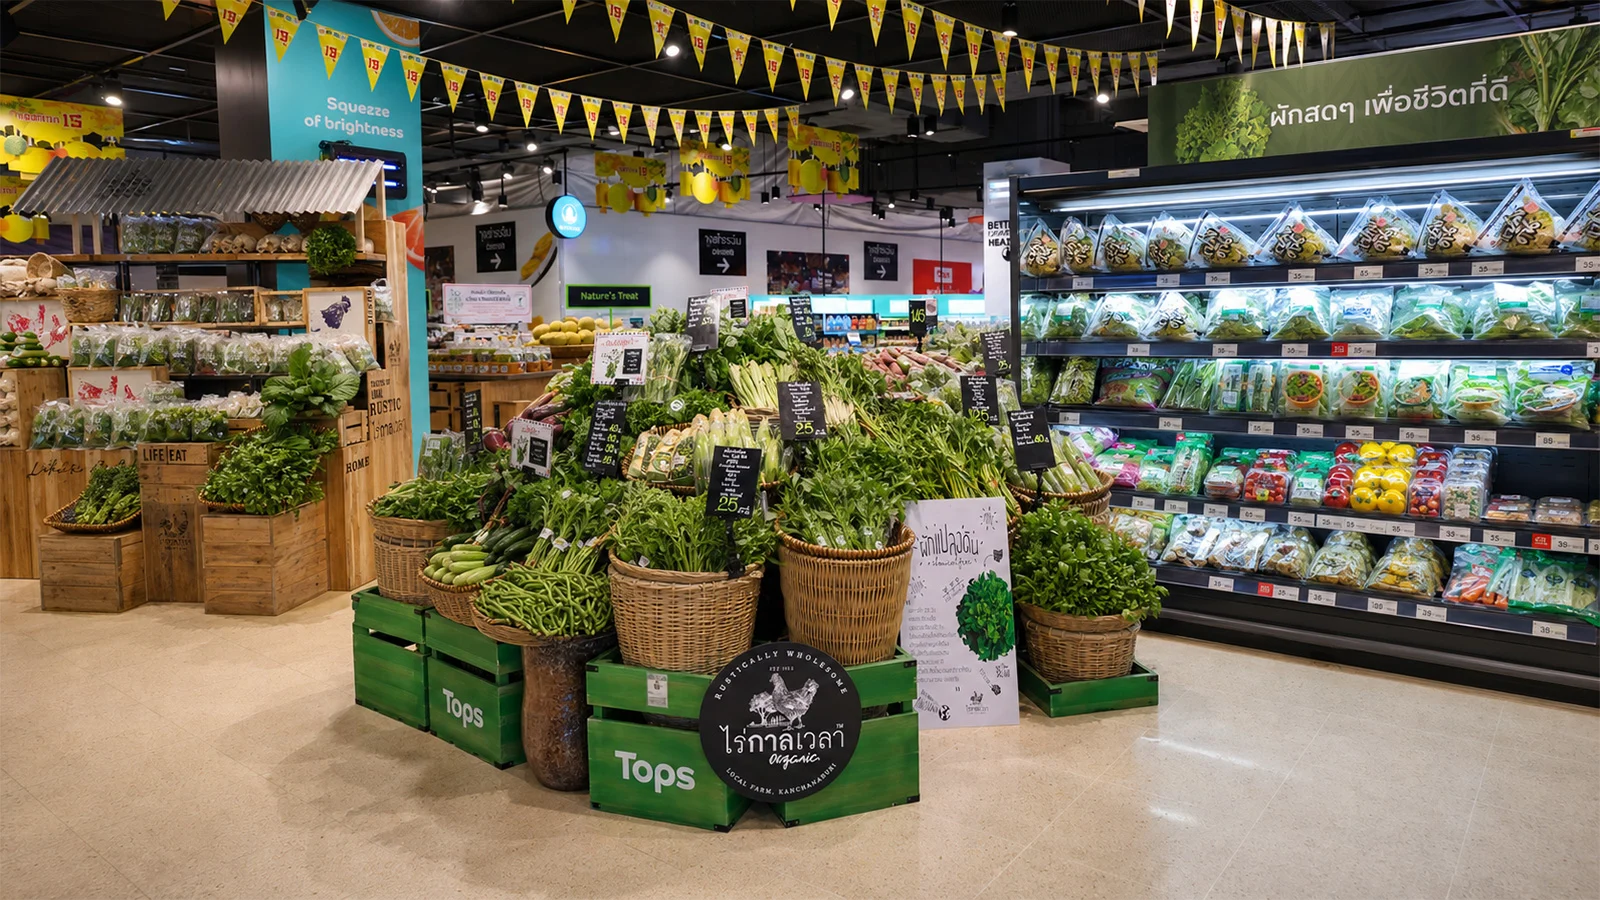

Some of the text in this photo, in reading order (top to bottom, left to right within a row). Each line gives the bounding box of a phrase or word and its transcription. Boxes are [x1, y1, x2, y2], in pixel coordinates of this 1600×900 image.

[326, 96, 391, 118] Squezze
[1270, 74, 1509, 128] ผักสดๆ เพื่อชีวิตที่ดี
[304, 115, 405, 139] of brightness
[580, 290, 639, 301] Nature's Treat
[369, 397, 402, 416] RUSTIC
[795, 422, 814, 435] 25
[142, 447, 188, 462] LIFE EAT
[345, 456, 371, 475] HOME
[717, 496, 738, 512] 25
[714, 650, 779, 700] RUSTICALLY
[786, 649, 848, 694] WHOLESOME
[442, 688, 484, 728] Tops
[719, 723, 844, 754] ไร่กาลเวลา
[614, 750, 696, 793] Tops
[726, 762, 838, 796] LOCAL FARM, KANCHANABURI
